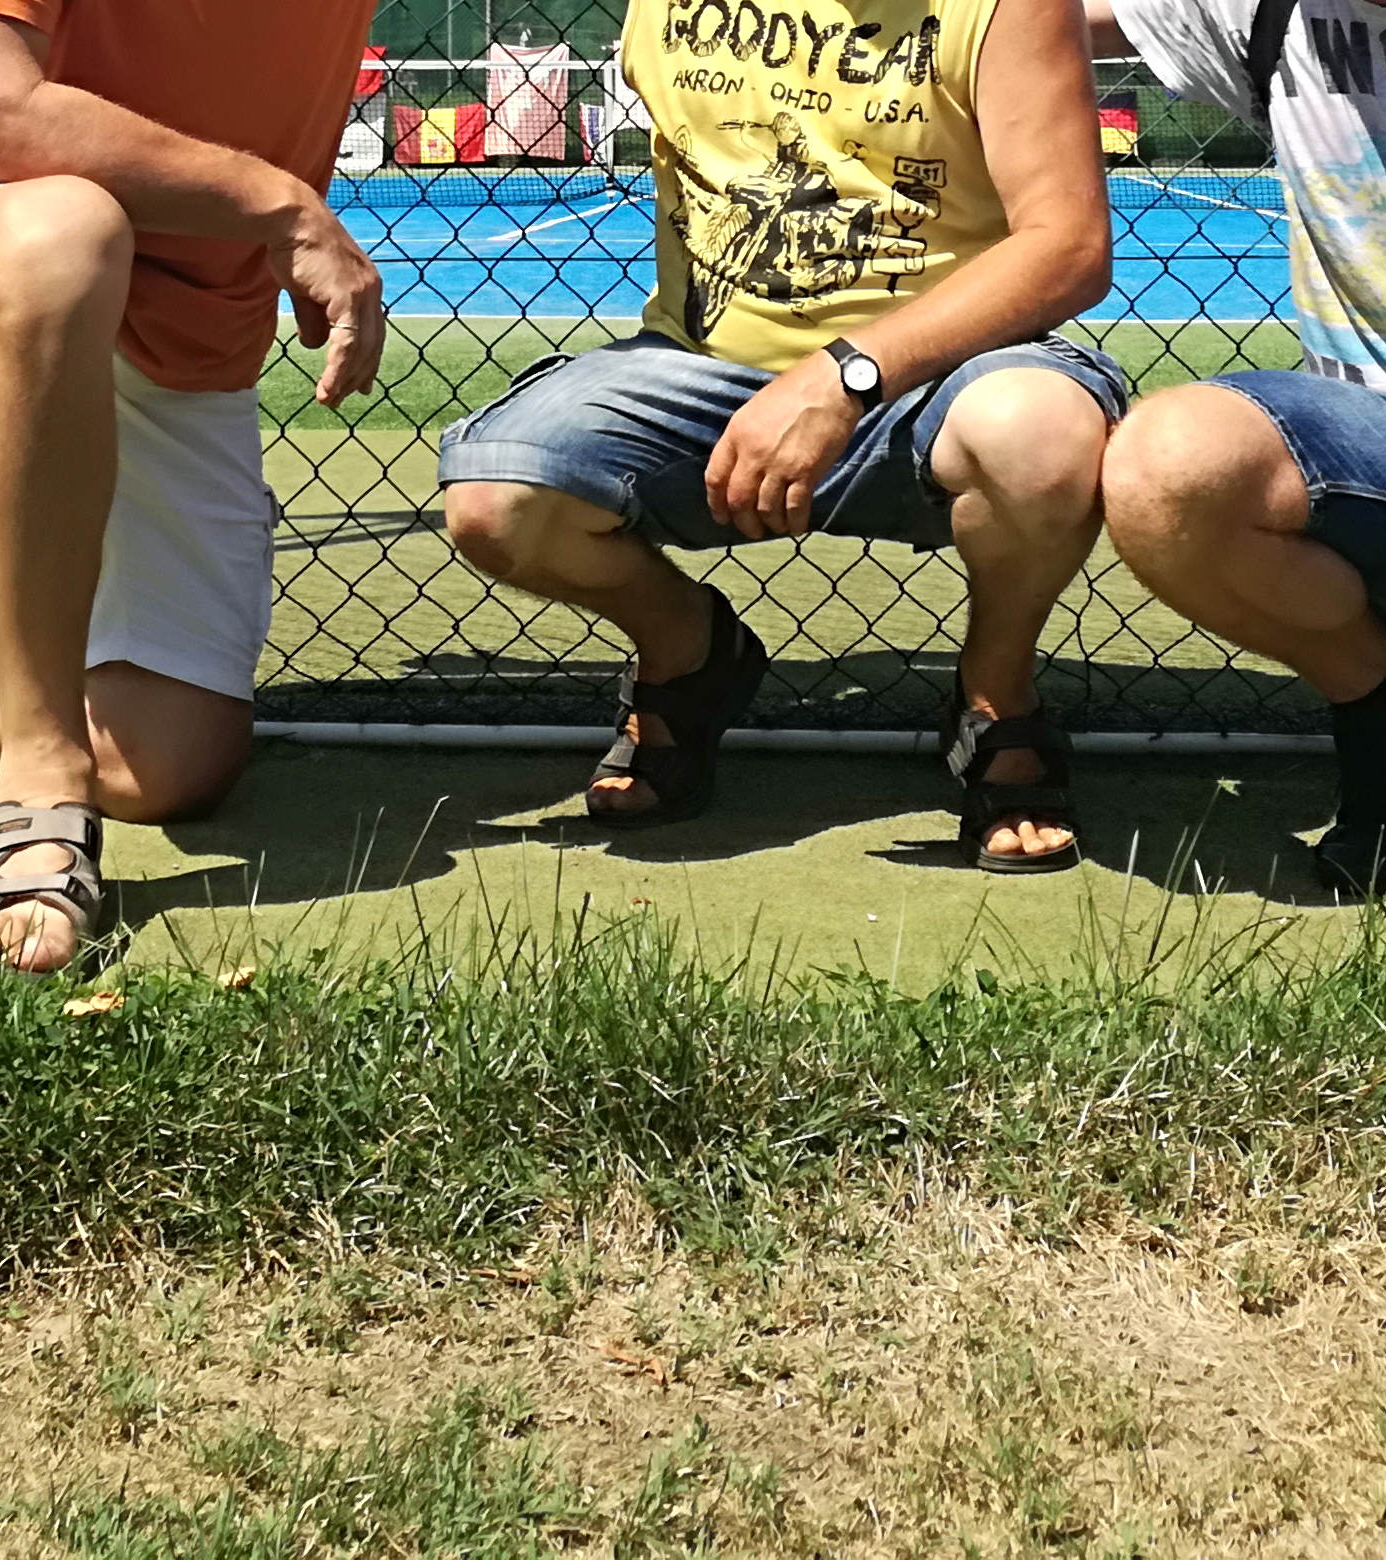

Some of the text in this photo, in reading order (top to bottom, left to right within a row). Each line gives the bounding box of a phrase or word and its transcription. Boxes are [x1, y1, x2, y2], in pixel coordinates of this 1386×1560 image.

[673, 68, 744, 95] AKRON
[770, 81, 833, 115] OHIO
[864, 99, 930, 124] U.S.A.
